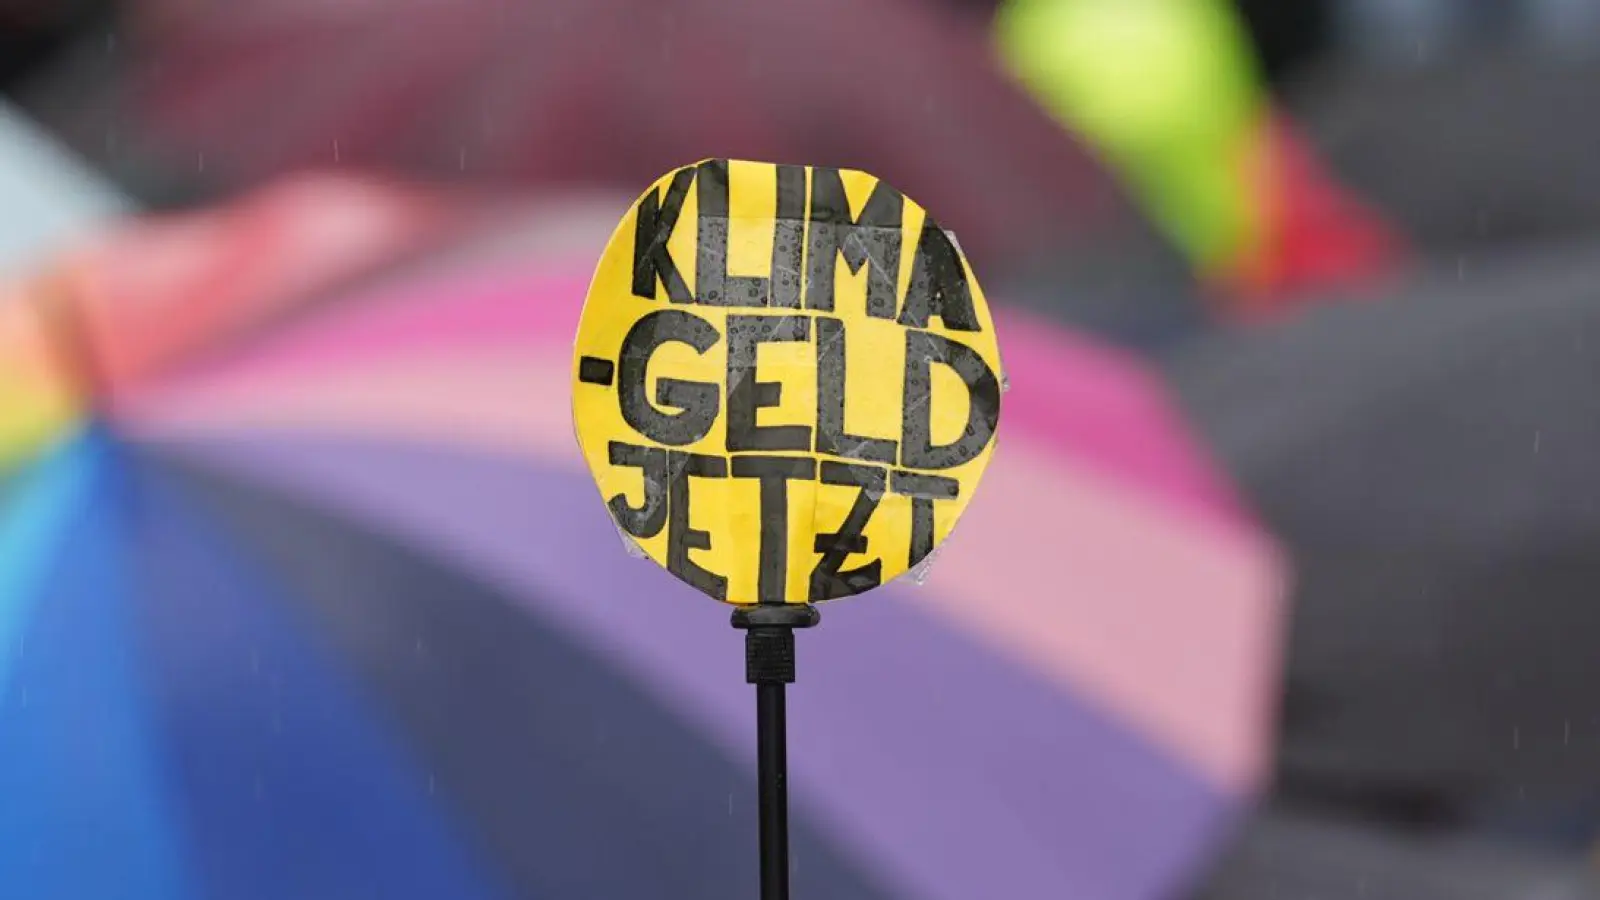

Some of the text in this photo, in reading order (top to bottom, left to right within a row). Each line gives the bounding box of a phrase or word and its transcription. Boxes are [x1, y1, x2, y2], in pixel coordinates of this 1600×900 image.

[632, 159, 981, 331] KLIMA
[579, 309, 1000, 469] -GELD
[608, 441, 959, 604] JETZT
